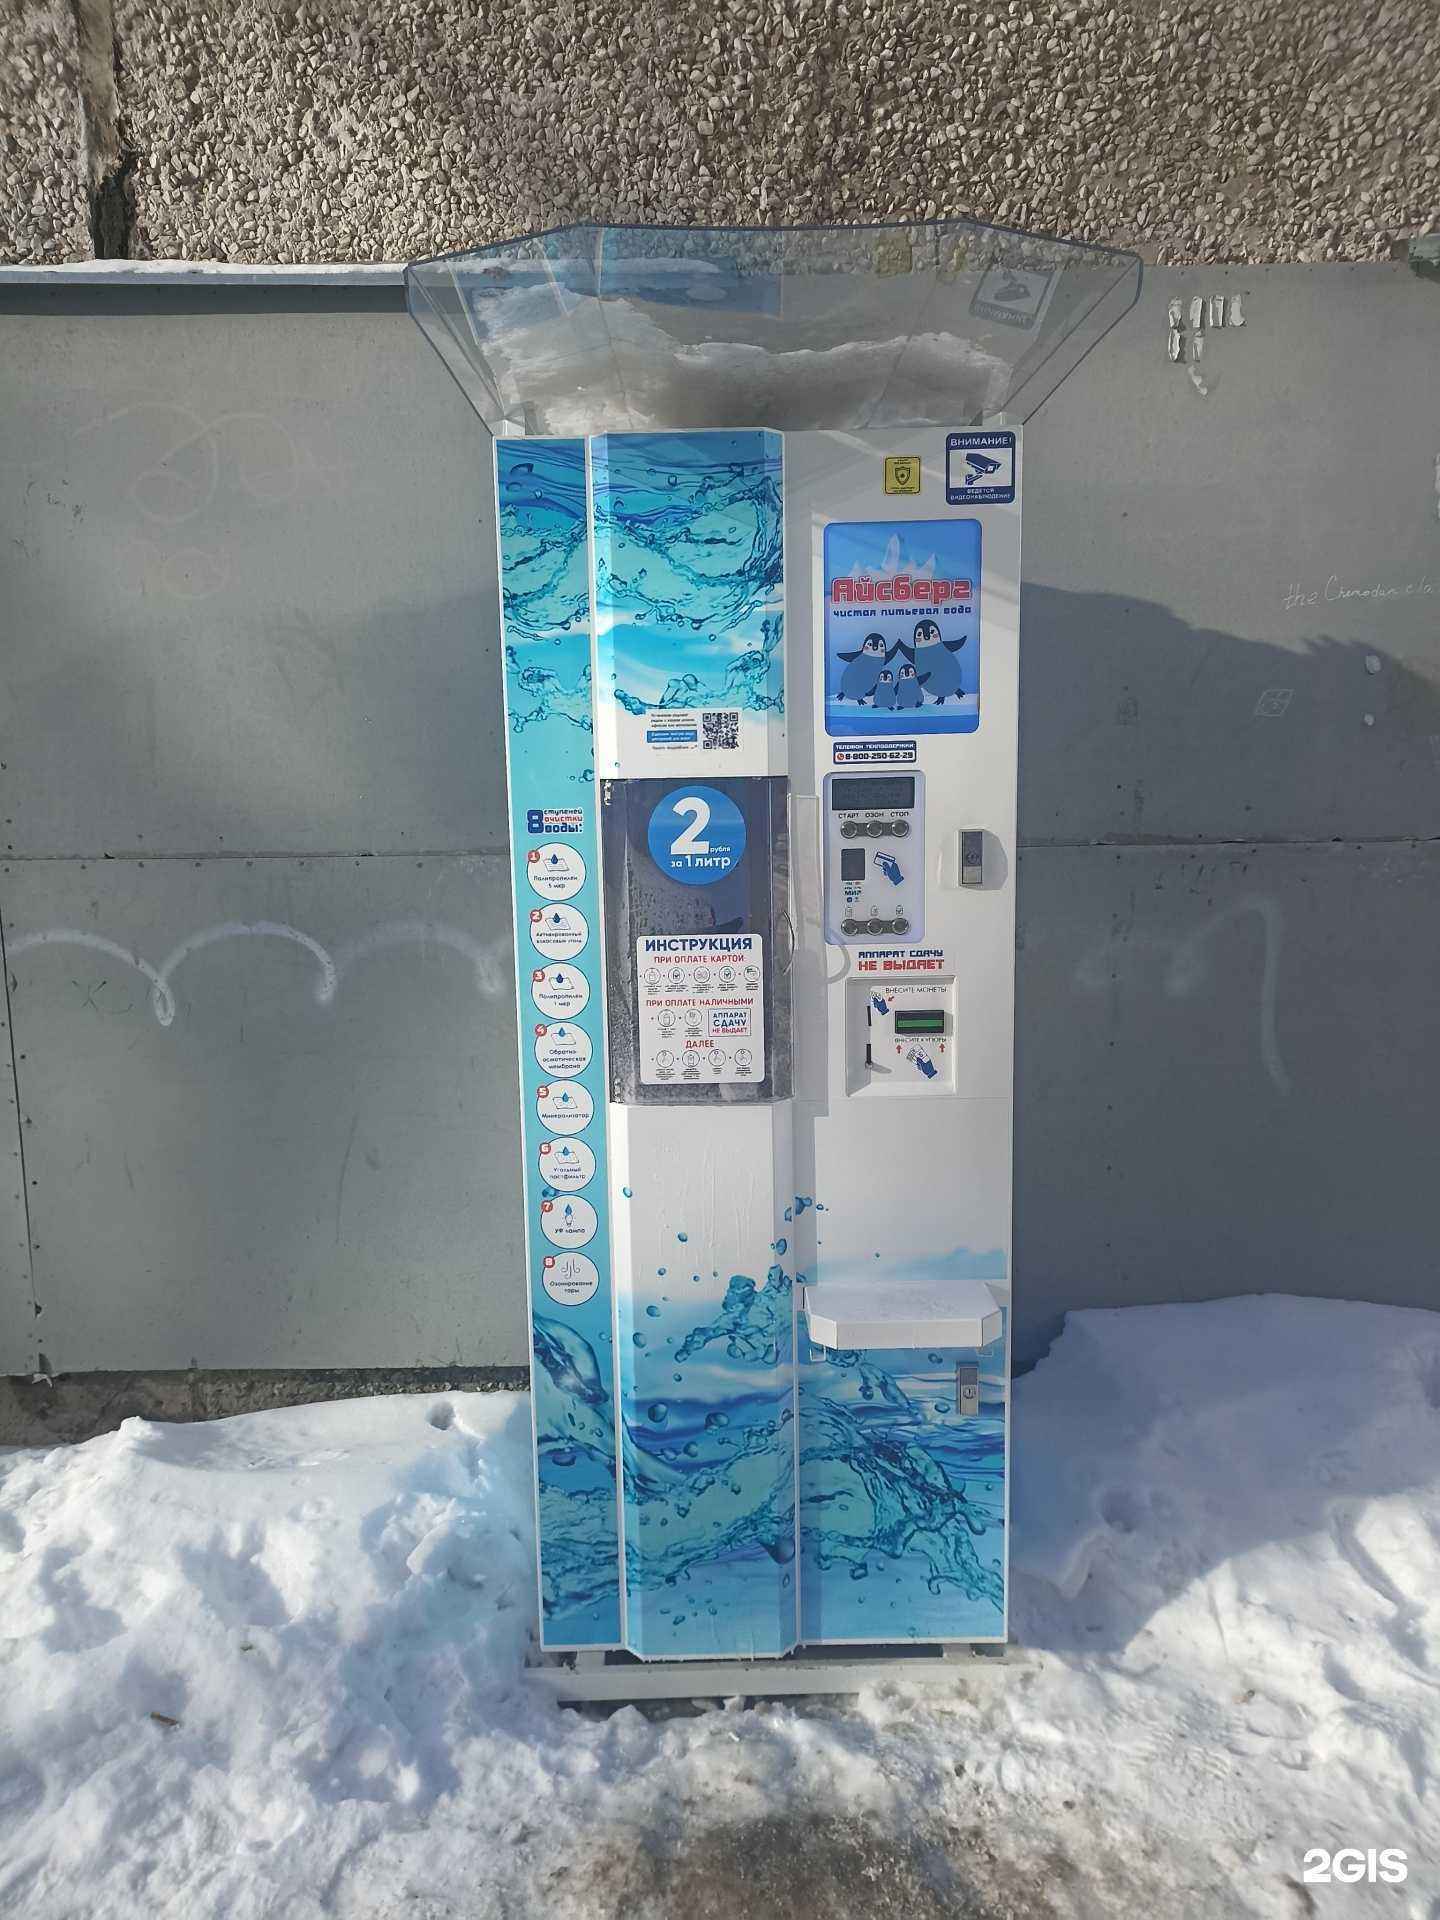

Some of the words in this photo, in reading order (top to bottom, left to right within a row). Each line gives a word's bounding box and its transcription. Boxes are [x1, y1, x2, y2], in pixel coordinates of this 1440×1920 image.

[950, 436, 1012, 446] ВНИМАНИЕ!
[831, 575, 973, 605] Айсберг
[833, 608, 876, 617] чистая
[881, 607, 939, 616] питьевая
[943, 605, 972, 614] вода
[544, 808, 582, 816] ступеней
[527, 809, 544, 833] 8
[671, 796, 710, 854] 2
[685, 855, 692, 867] 1
[694, 857, 731, 869] литр
[645, 938, 752, 951] ИНСТРУКЦИЯ
[674, 955, 707, 963] ОПЛАТЕ
[710, 953, 744, 962] КАРТОЙ
[858, 950, 905, 958] АППАРАТ
[909, 949, 943, 957] СДАЧУ
[858, 961, 877, 970] НЕ
[883, 959, 944, 970] ВЫДАЕТ
[646, 999, 662, 1007] ПРИ
[700, 998, 754, 1006] НАЛИЧНЫМИ
[713, 1019, 747, 1027] СДАЧУ
[685, 1040, 715, 1048] ДАЛЕЕ
